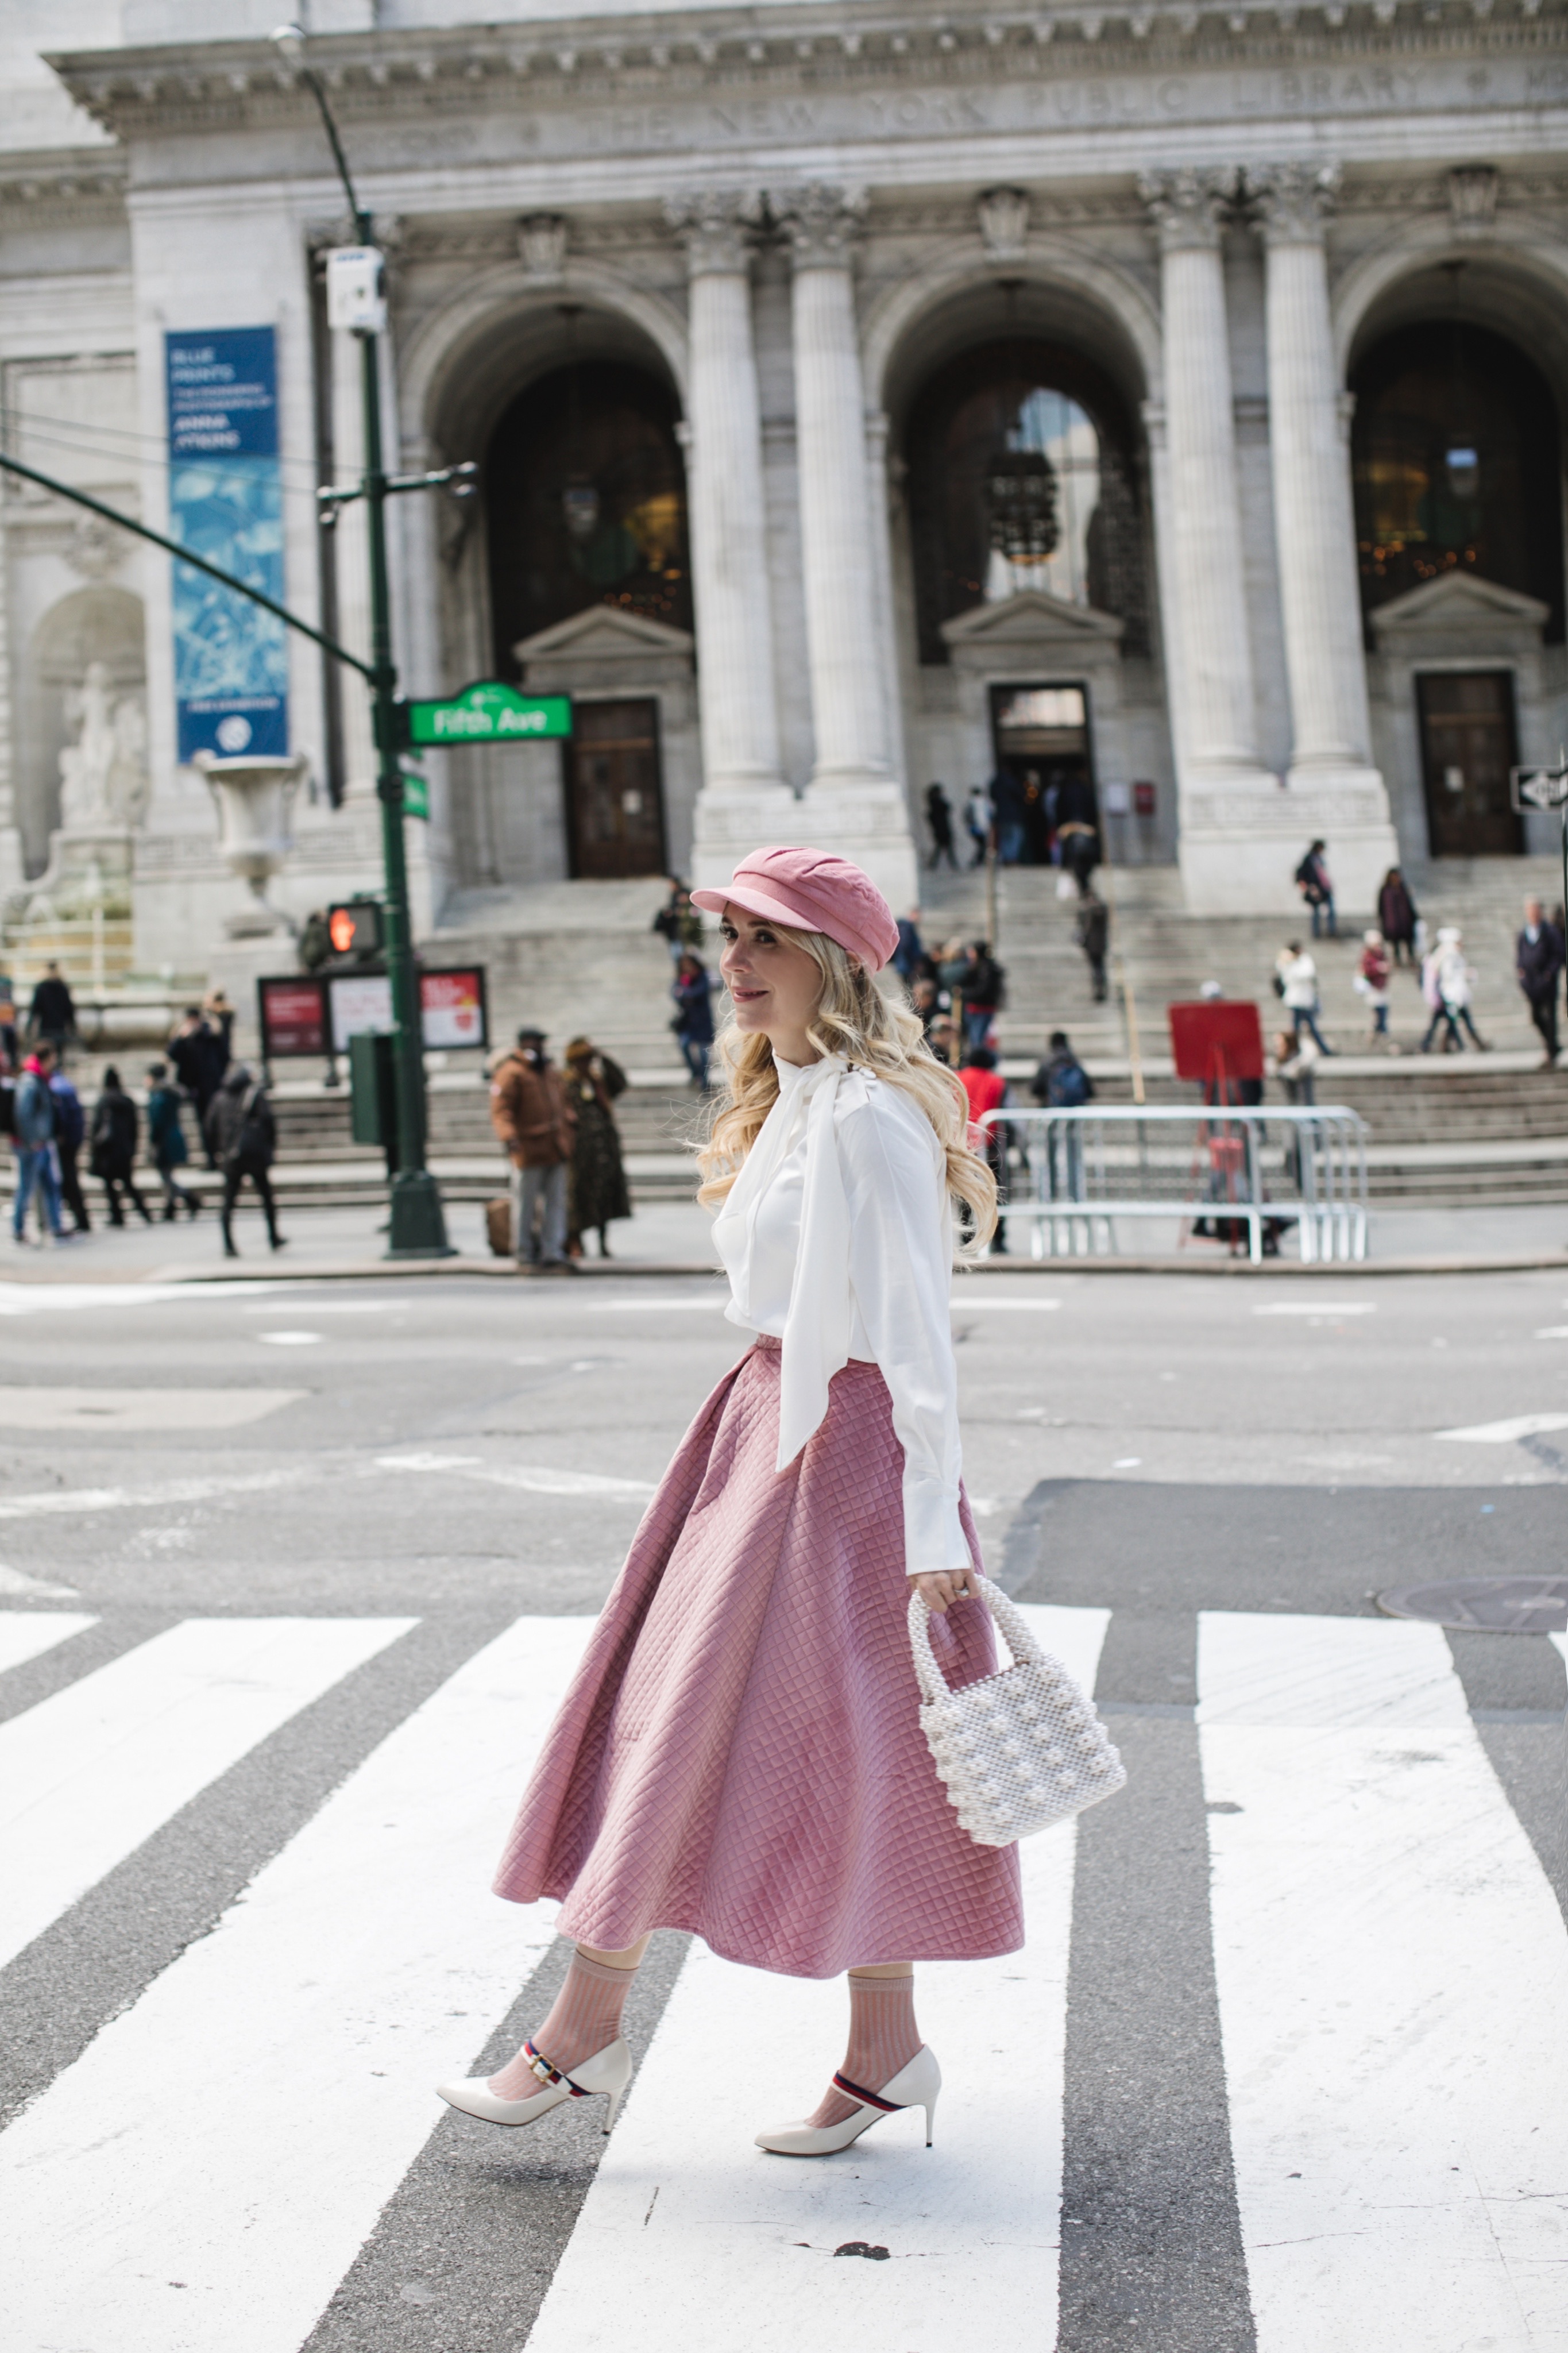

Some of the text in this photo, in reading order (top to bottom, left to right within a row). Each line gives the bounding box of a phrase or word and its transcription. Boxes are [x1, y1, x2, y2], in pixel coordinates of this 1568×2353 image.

[576, 106, 674, 148] THE
[709, 98, 821, 136] NEW
[866, 90, 990, 128] YORK
[1025, 78, 1189, 118] PUBLIC
[1232, 63, 1427, 110] LIBRARY
[434, 707, 547, 734] Fifth Ave
